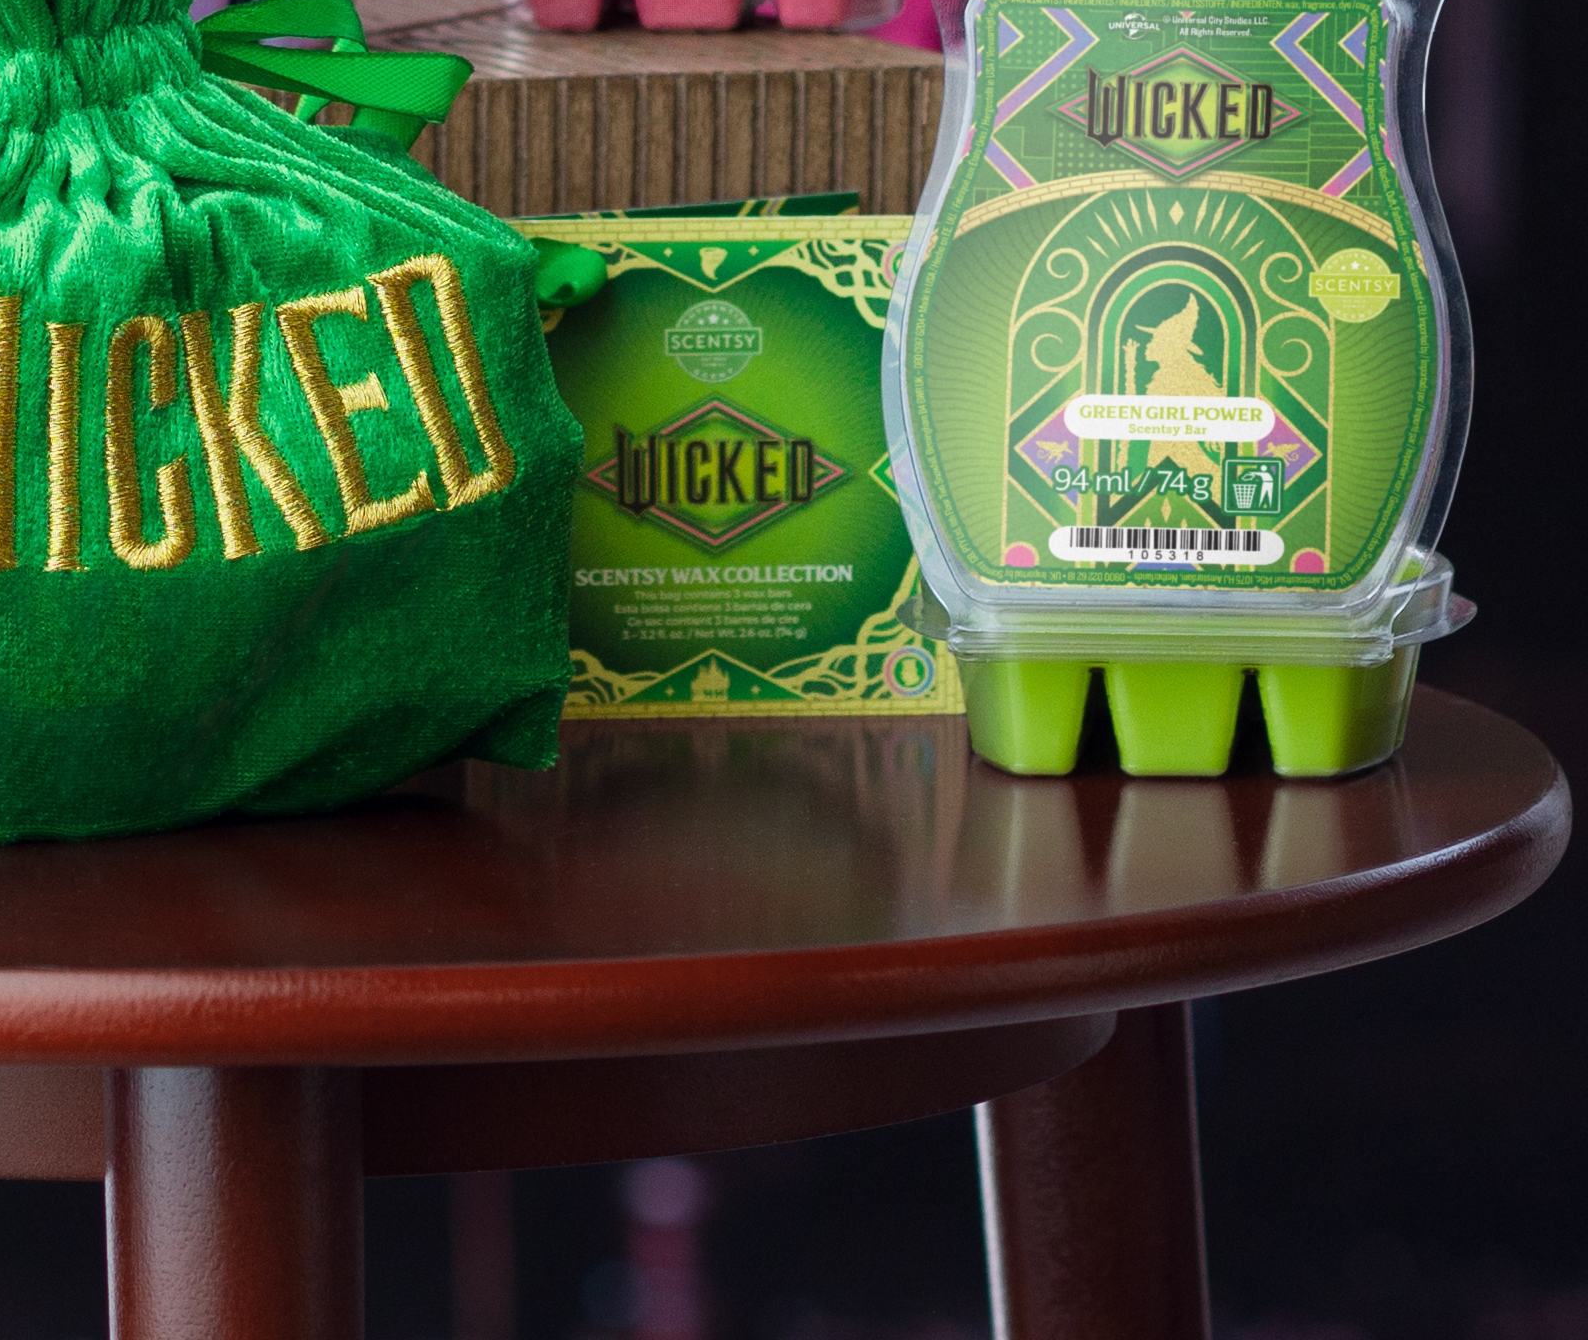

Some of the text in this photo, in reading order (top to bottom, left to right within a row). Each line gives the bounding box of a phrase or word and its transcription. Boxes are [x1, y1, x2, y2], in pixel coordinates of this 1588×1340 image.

[1108, 21, 1161, 31] UNIVERSAL
[1172, 15, 1270, 26] Universal City Studios LLC.
[1179, 27, 1253, 37] All Rights Reserved.
[1085, 64, 1274, 150] WICKED
[1314, 278, 1394, 292] SCENTSY
[670, 334, 756, 350] SCENTSY
[1079, 405, 1263, 422] GREEN GIRL POWER
[1128, 423, 1208, 436] Scentsy Bar
[614, 422, 814, 518] WICKED
[1054, 468, 1090, 492] 94
[1095, 469, 1130, 493] ml
[1156, 469, 1188, 494] 74
[1193, 475, 1210, 501] g
[1127, 549, 1205, 562] 105318
[575, 563, 854, 586] SCENTSY WAX COLLECTION
